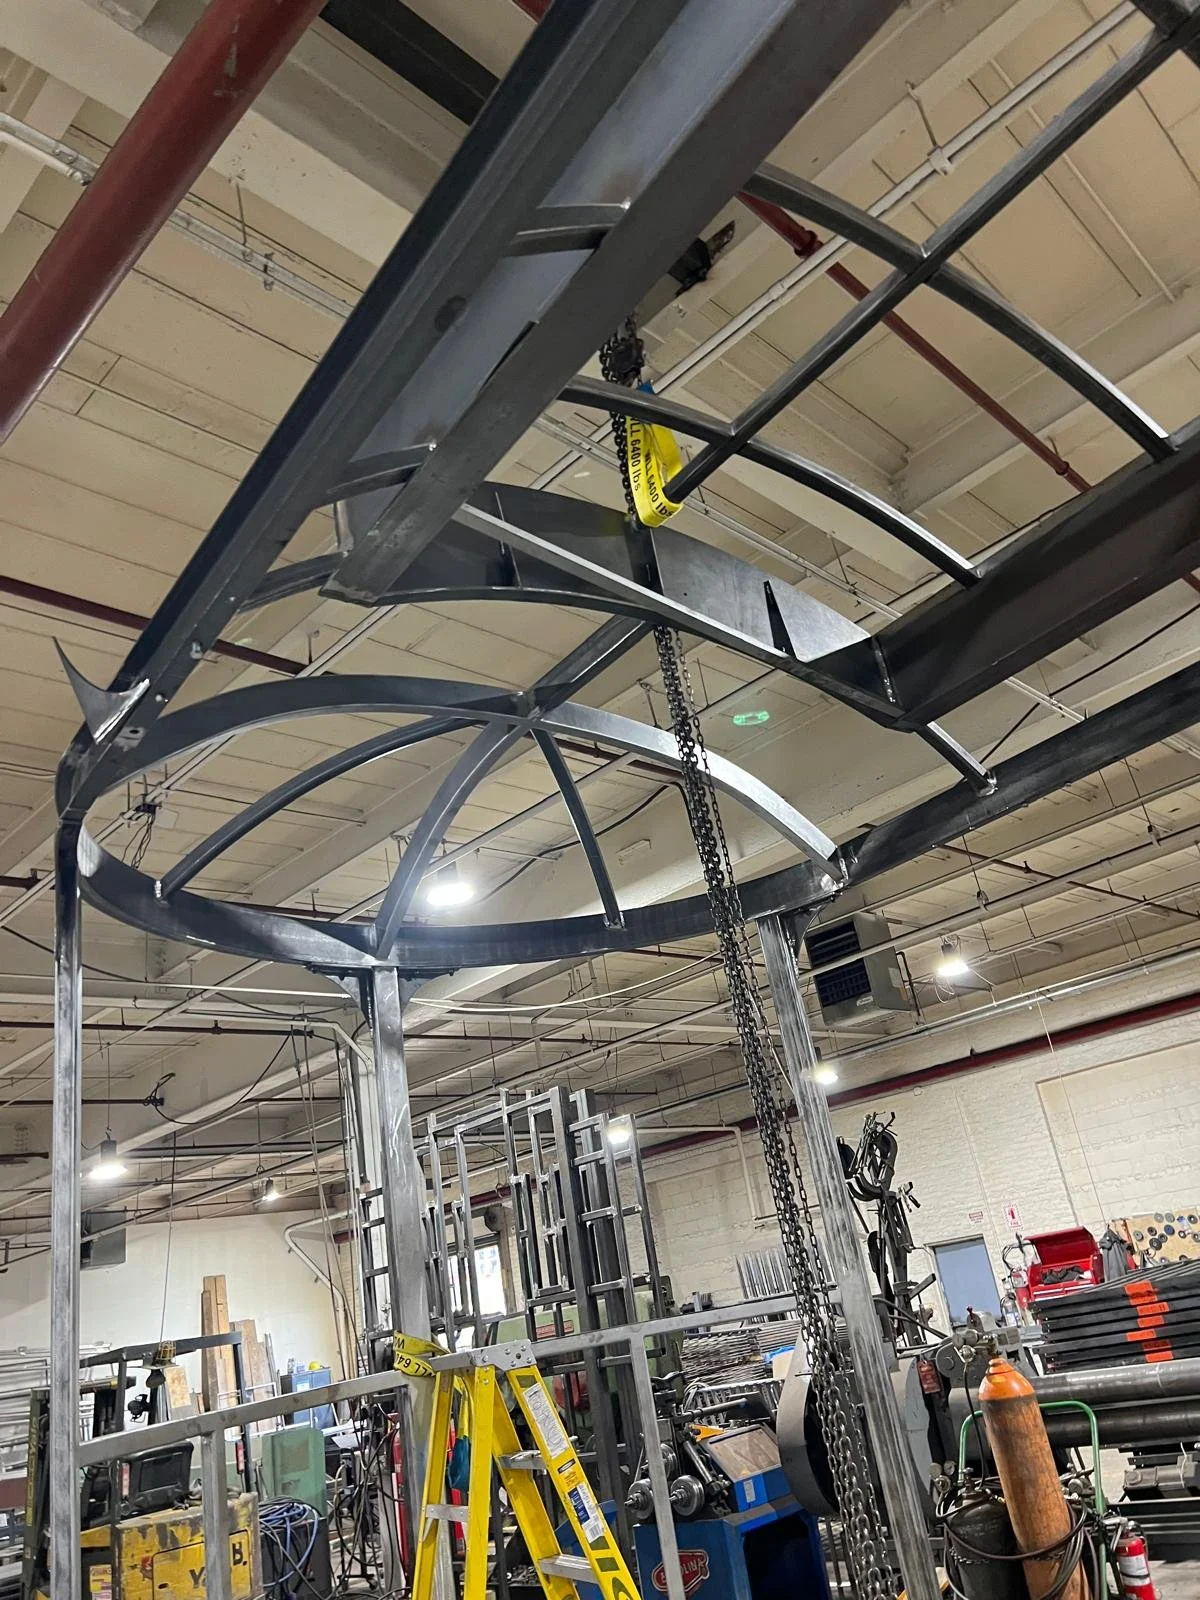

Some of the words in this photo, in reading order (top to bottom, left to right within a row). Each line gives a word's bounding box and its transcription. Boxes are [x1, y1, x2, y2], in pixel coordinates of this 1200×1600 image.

[631, 439, 641, 467] 6400
[632, 469, 641, 491] lbs
[648, 474, 659, 503] 6400
[656, 502, 672, 517] lbs
